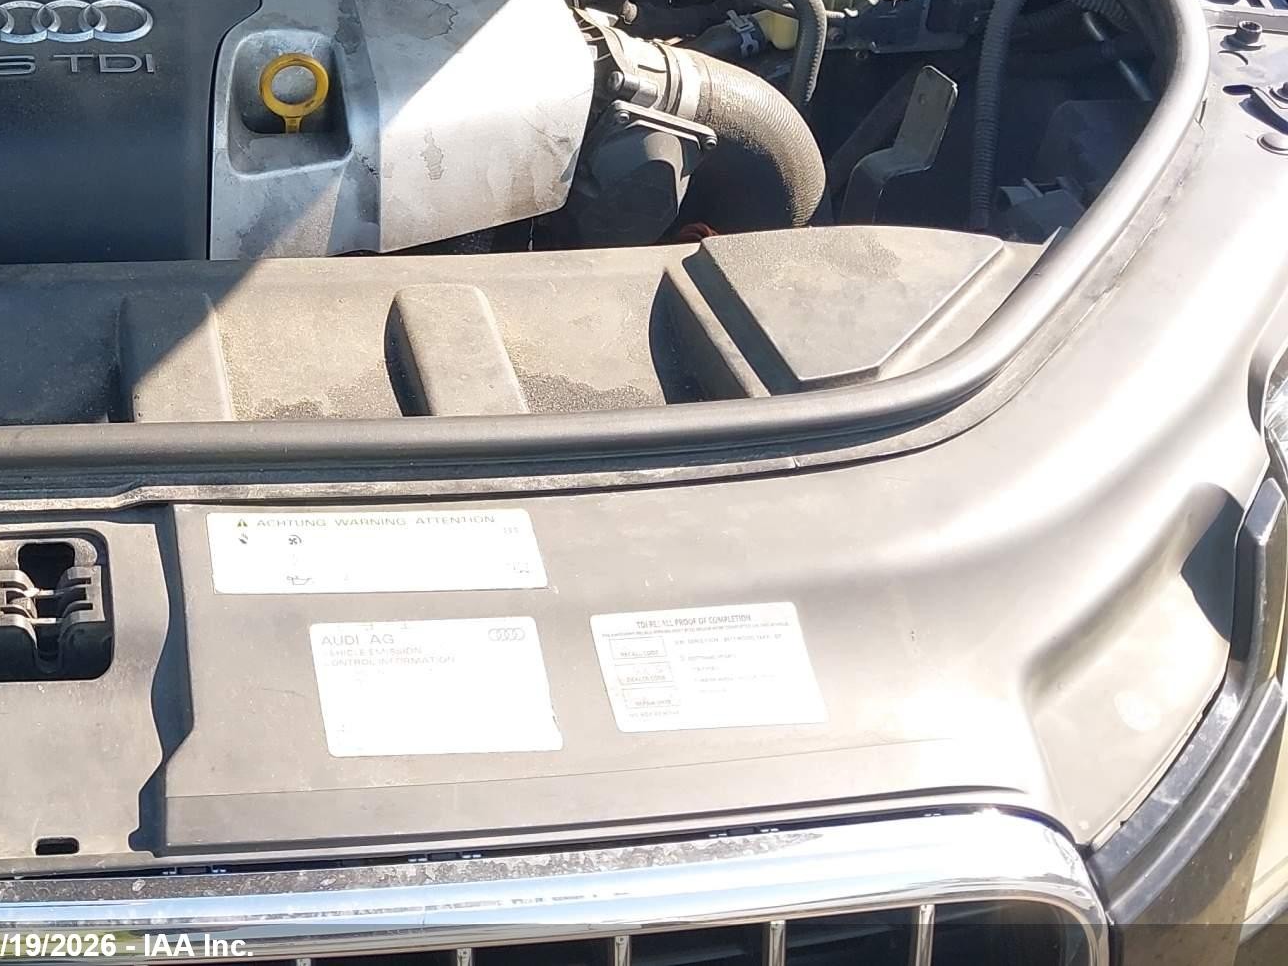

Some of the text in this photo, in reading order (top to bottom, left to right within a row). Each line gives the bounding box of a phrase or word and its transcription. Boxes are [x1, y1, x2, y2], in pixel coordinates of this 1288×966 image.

[53, 53, 155, 73] TDI
[256, 516, 495, 527] ACHTUNG WARNING ATTENTION
[708, 614, 751, 624] COMPLETION
[321, 634, 395, 645] AUDI AG
